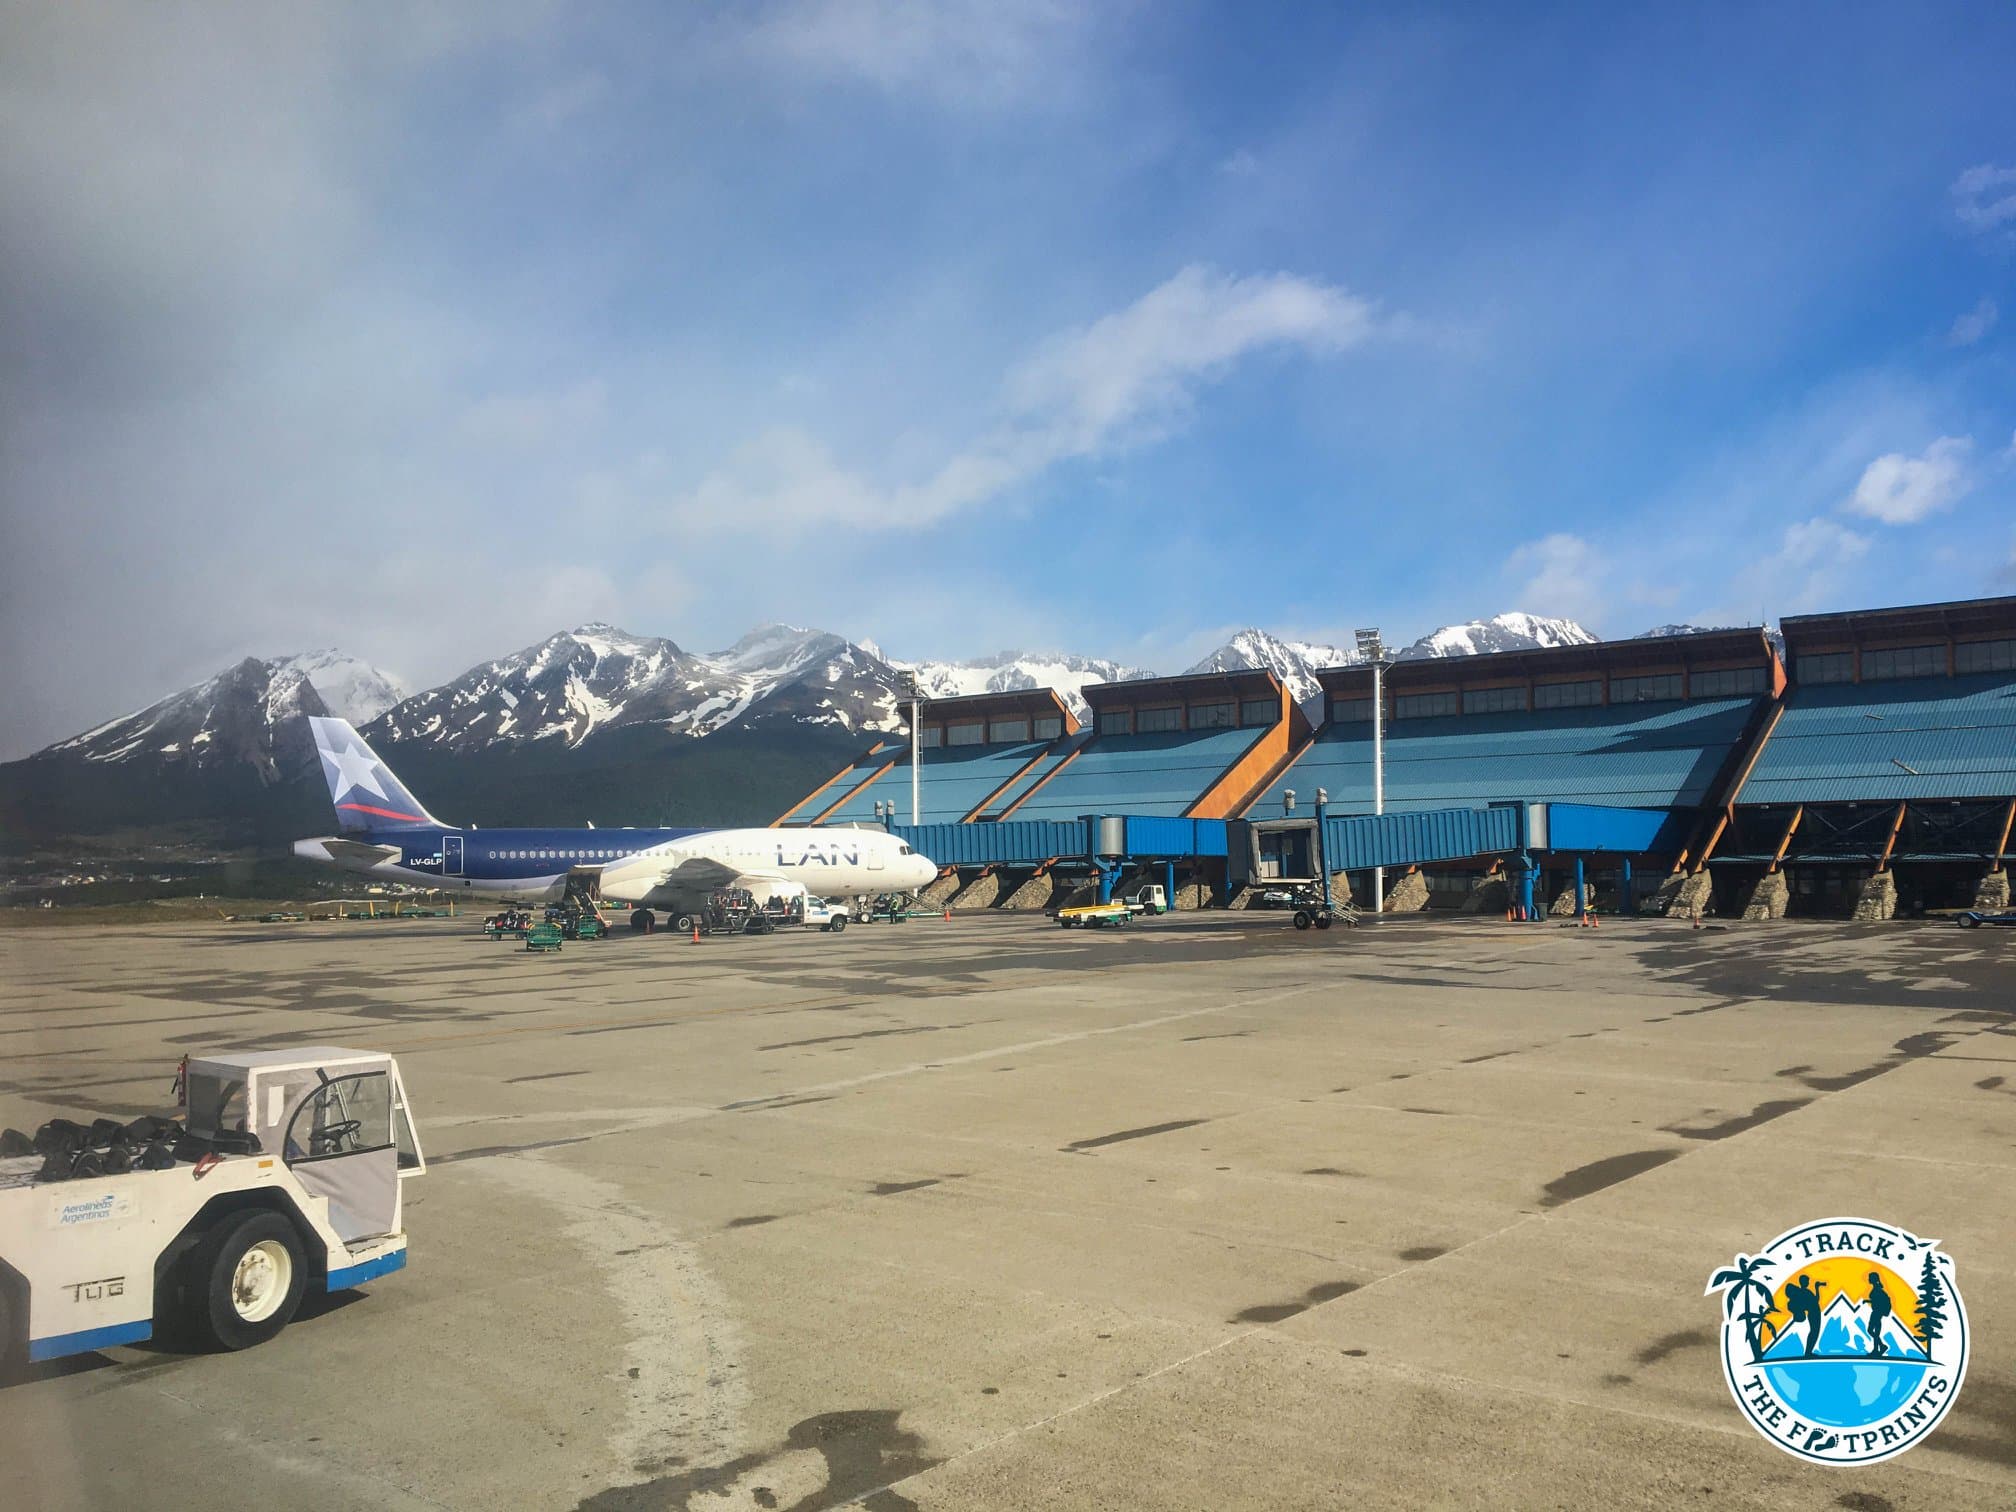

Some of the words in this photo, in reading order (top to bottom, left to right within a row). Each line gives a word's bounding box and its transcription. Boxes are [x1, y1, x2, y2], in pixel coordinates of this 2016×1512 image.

[410, 858, 442, 866] LV-GLP
[777, 844, 858, 866] LAN
[61, 1276, 125, 1303] TUG
